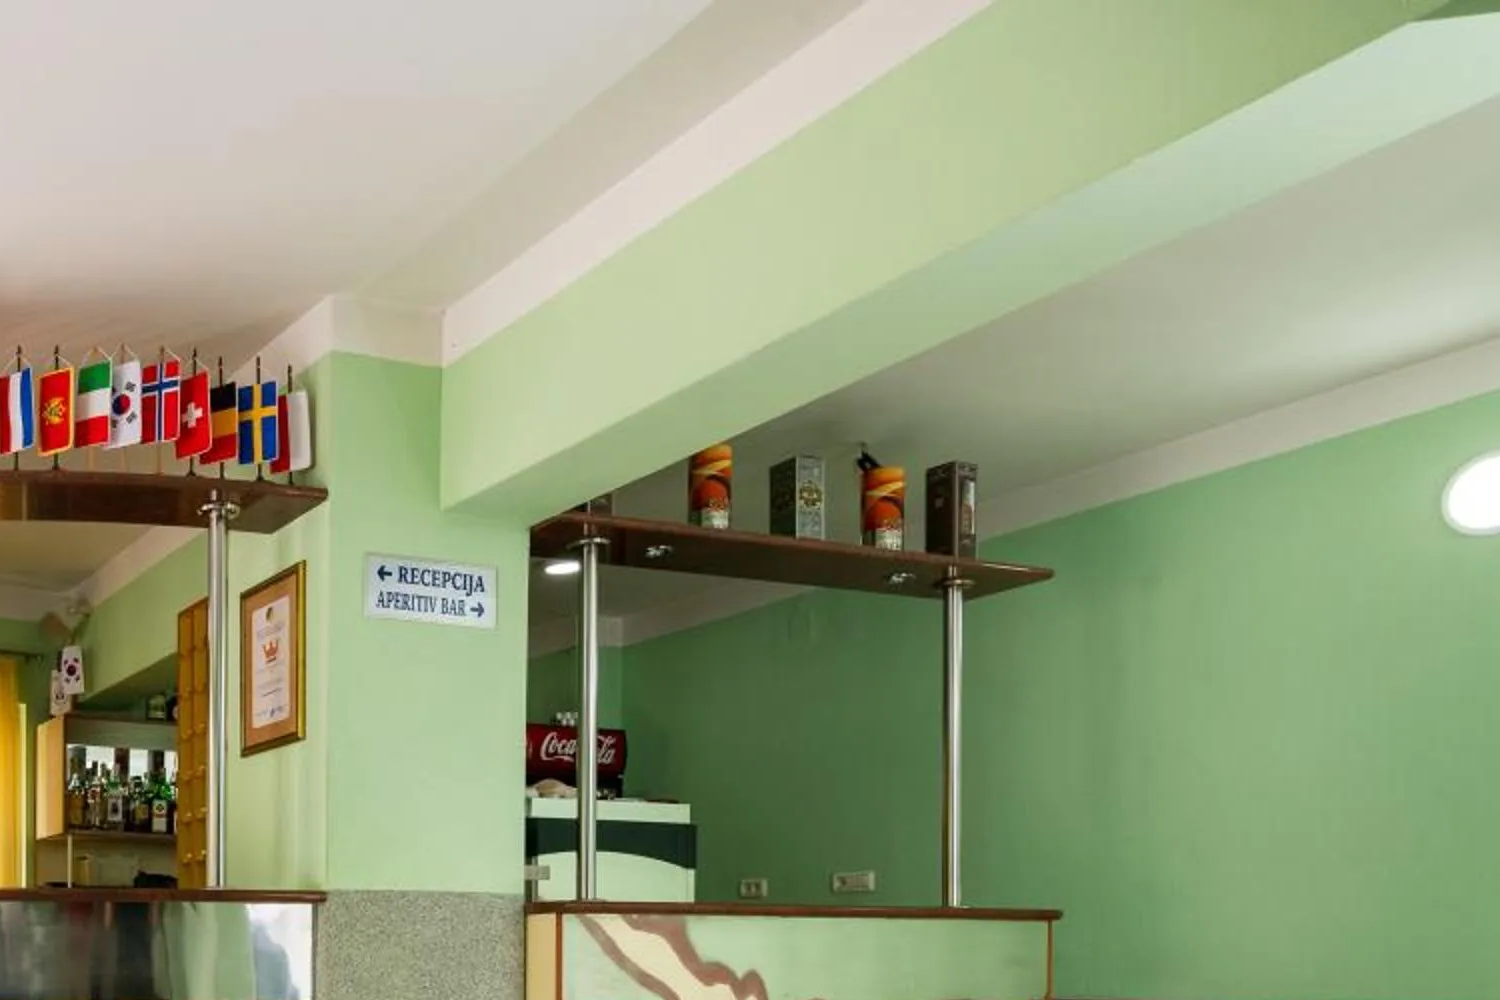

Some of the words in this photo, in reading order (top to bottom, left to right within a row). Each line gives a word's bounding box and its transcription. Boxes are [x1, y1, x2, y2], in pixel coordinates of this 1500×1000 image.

[397, 565, 485, 597] RECEPCIJA
[375, 590, 437, 613] APERITIV
[441, 597, 467, 617] BAR
